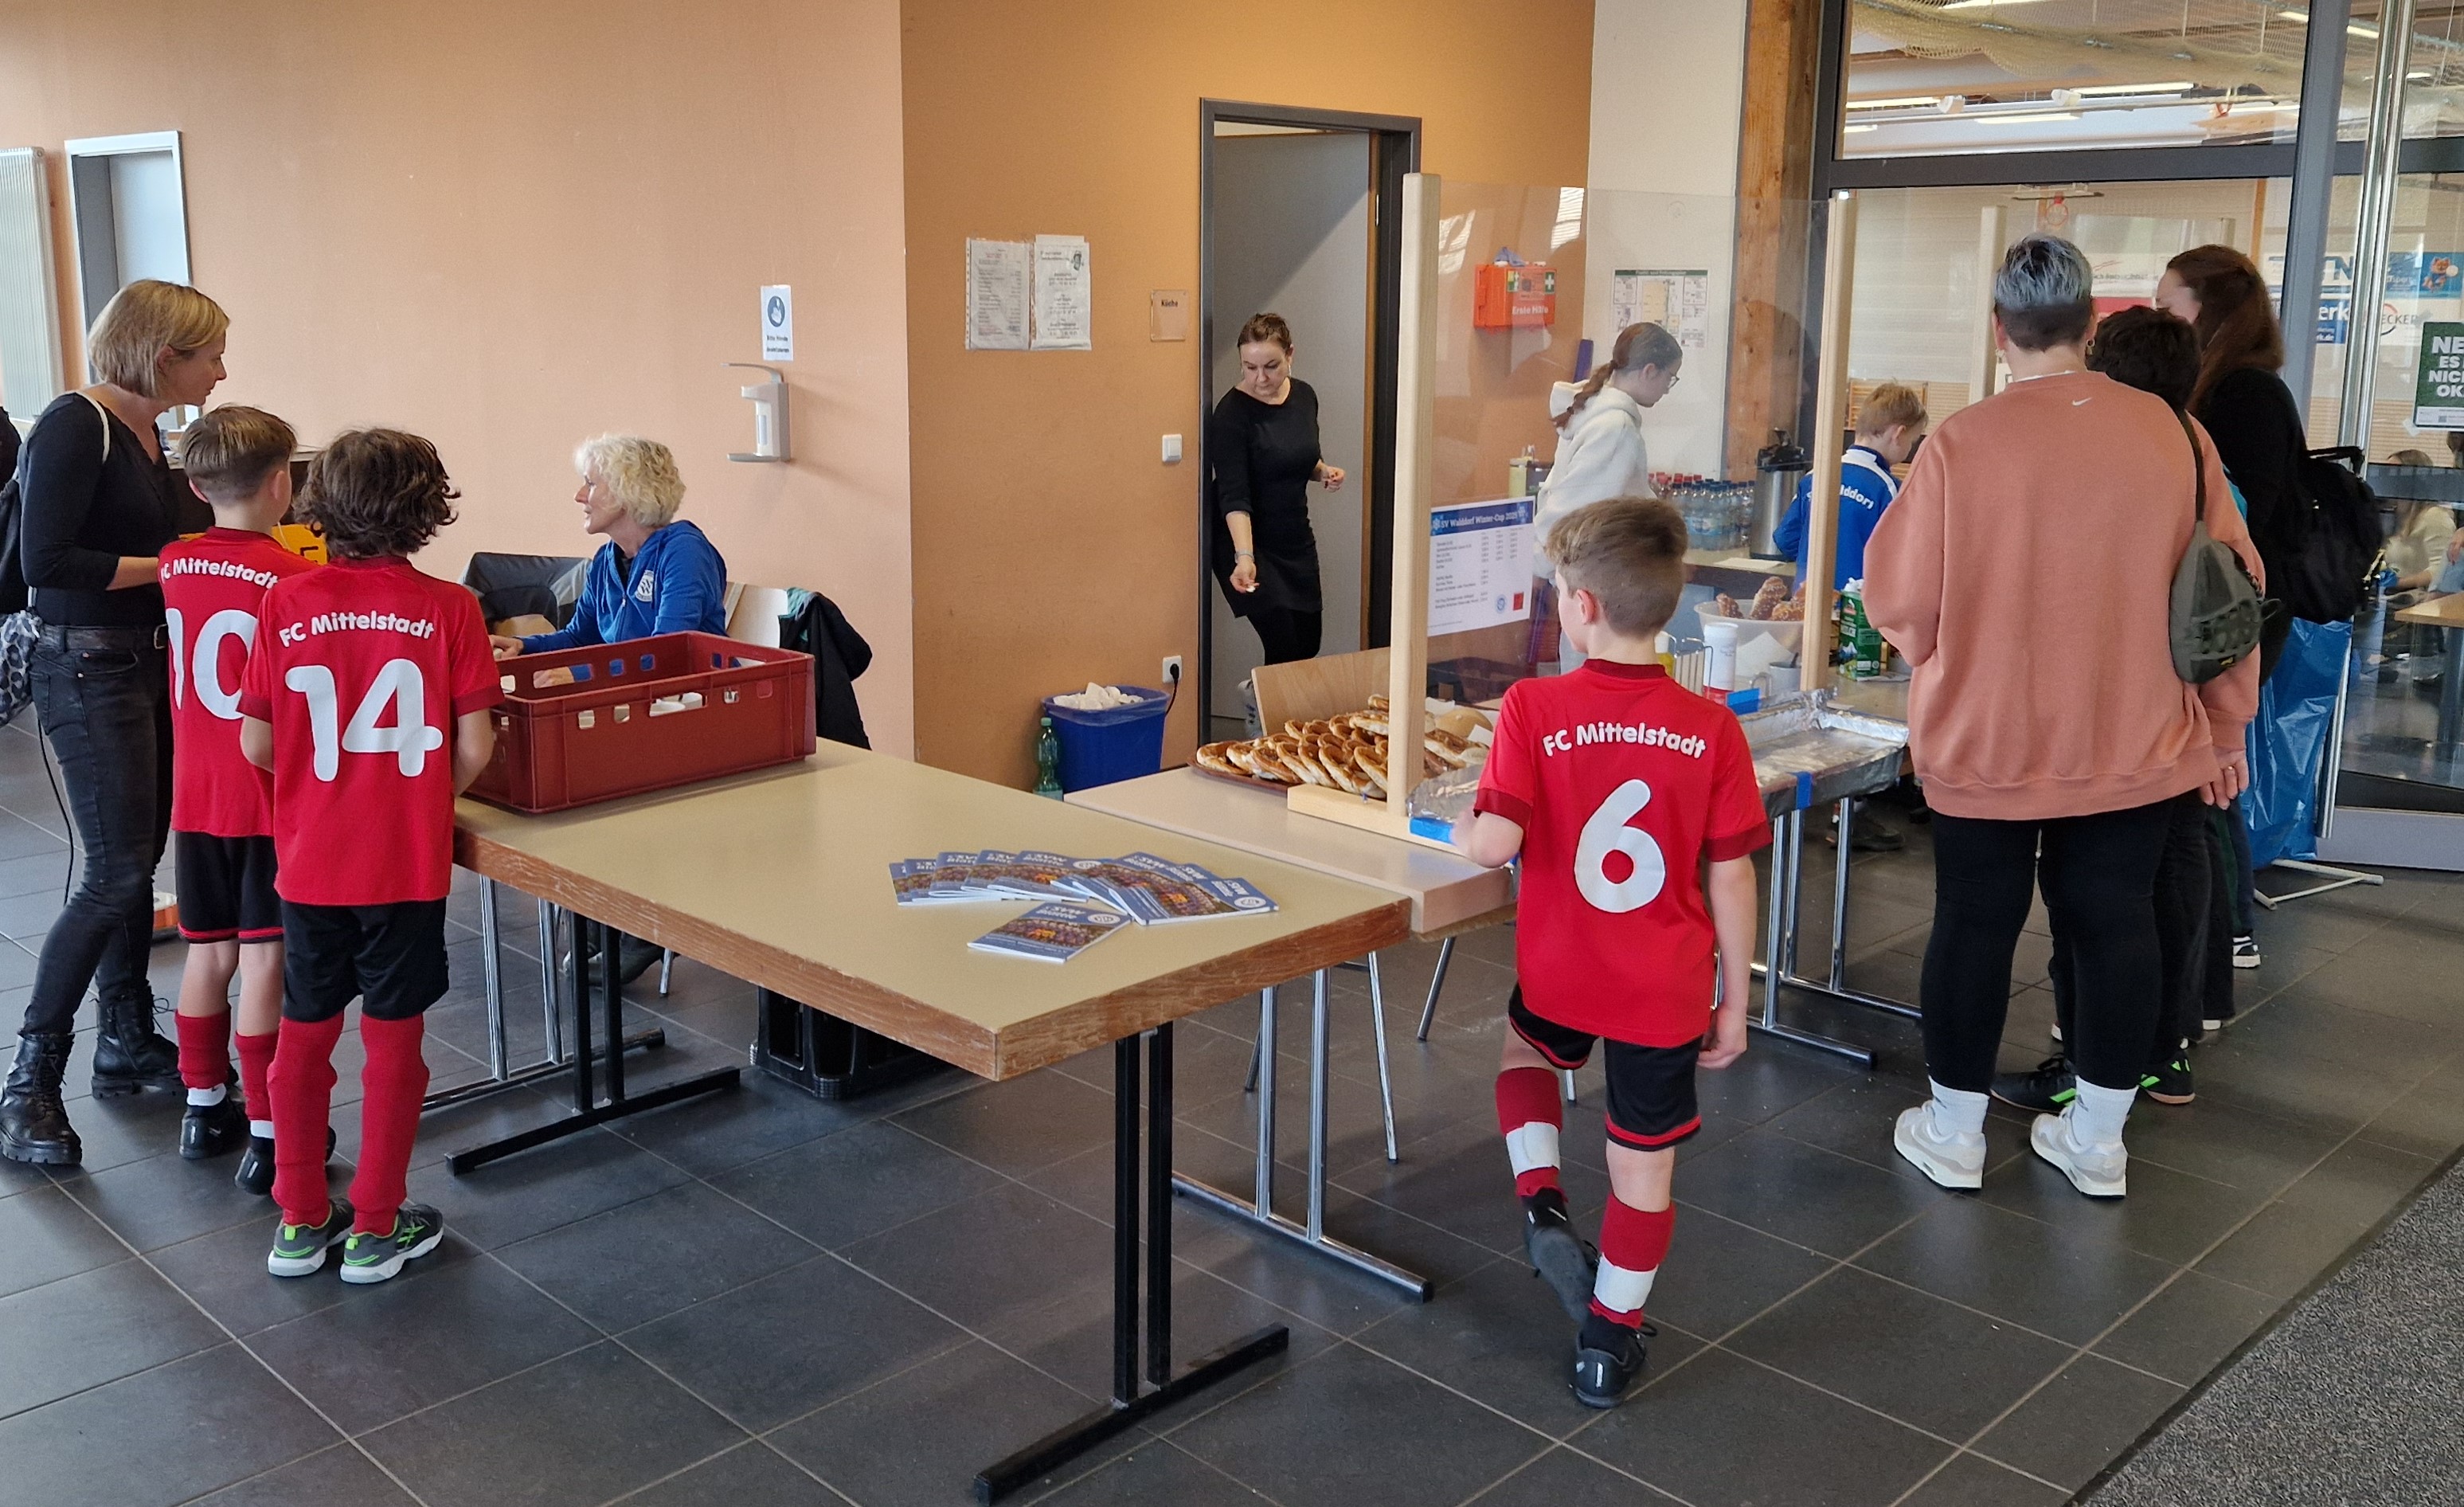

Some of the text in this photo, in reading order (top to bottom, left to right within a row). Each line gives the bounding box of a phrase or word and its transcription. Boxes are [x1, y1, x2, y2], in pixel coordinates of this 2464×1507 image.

[1512, 305, 1549, 315] Erste Hilfe
[2318, 301, 2350, 320] erk
[2381, 314, 2418, 325] ECKER
[2431, 335, 2464, 354] NE
[2439, 355, 2460, 368] ES
[2428, 370, 2464, 382] NIC
[2436, 384, 2464, 397] OK
[1840, 484, 1874, 510] lddorf
[173, 558, 279, 589] Mittelstadt
[279, 610, 435, 648] FC Mittelstadt
[166, 607, 260, 720] 10
[285, 658, 444, 782] 14
[1543, 721, 1707, 759] FC Mittelstadt
[1574, 778, 1667, 914] 6
